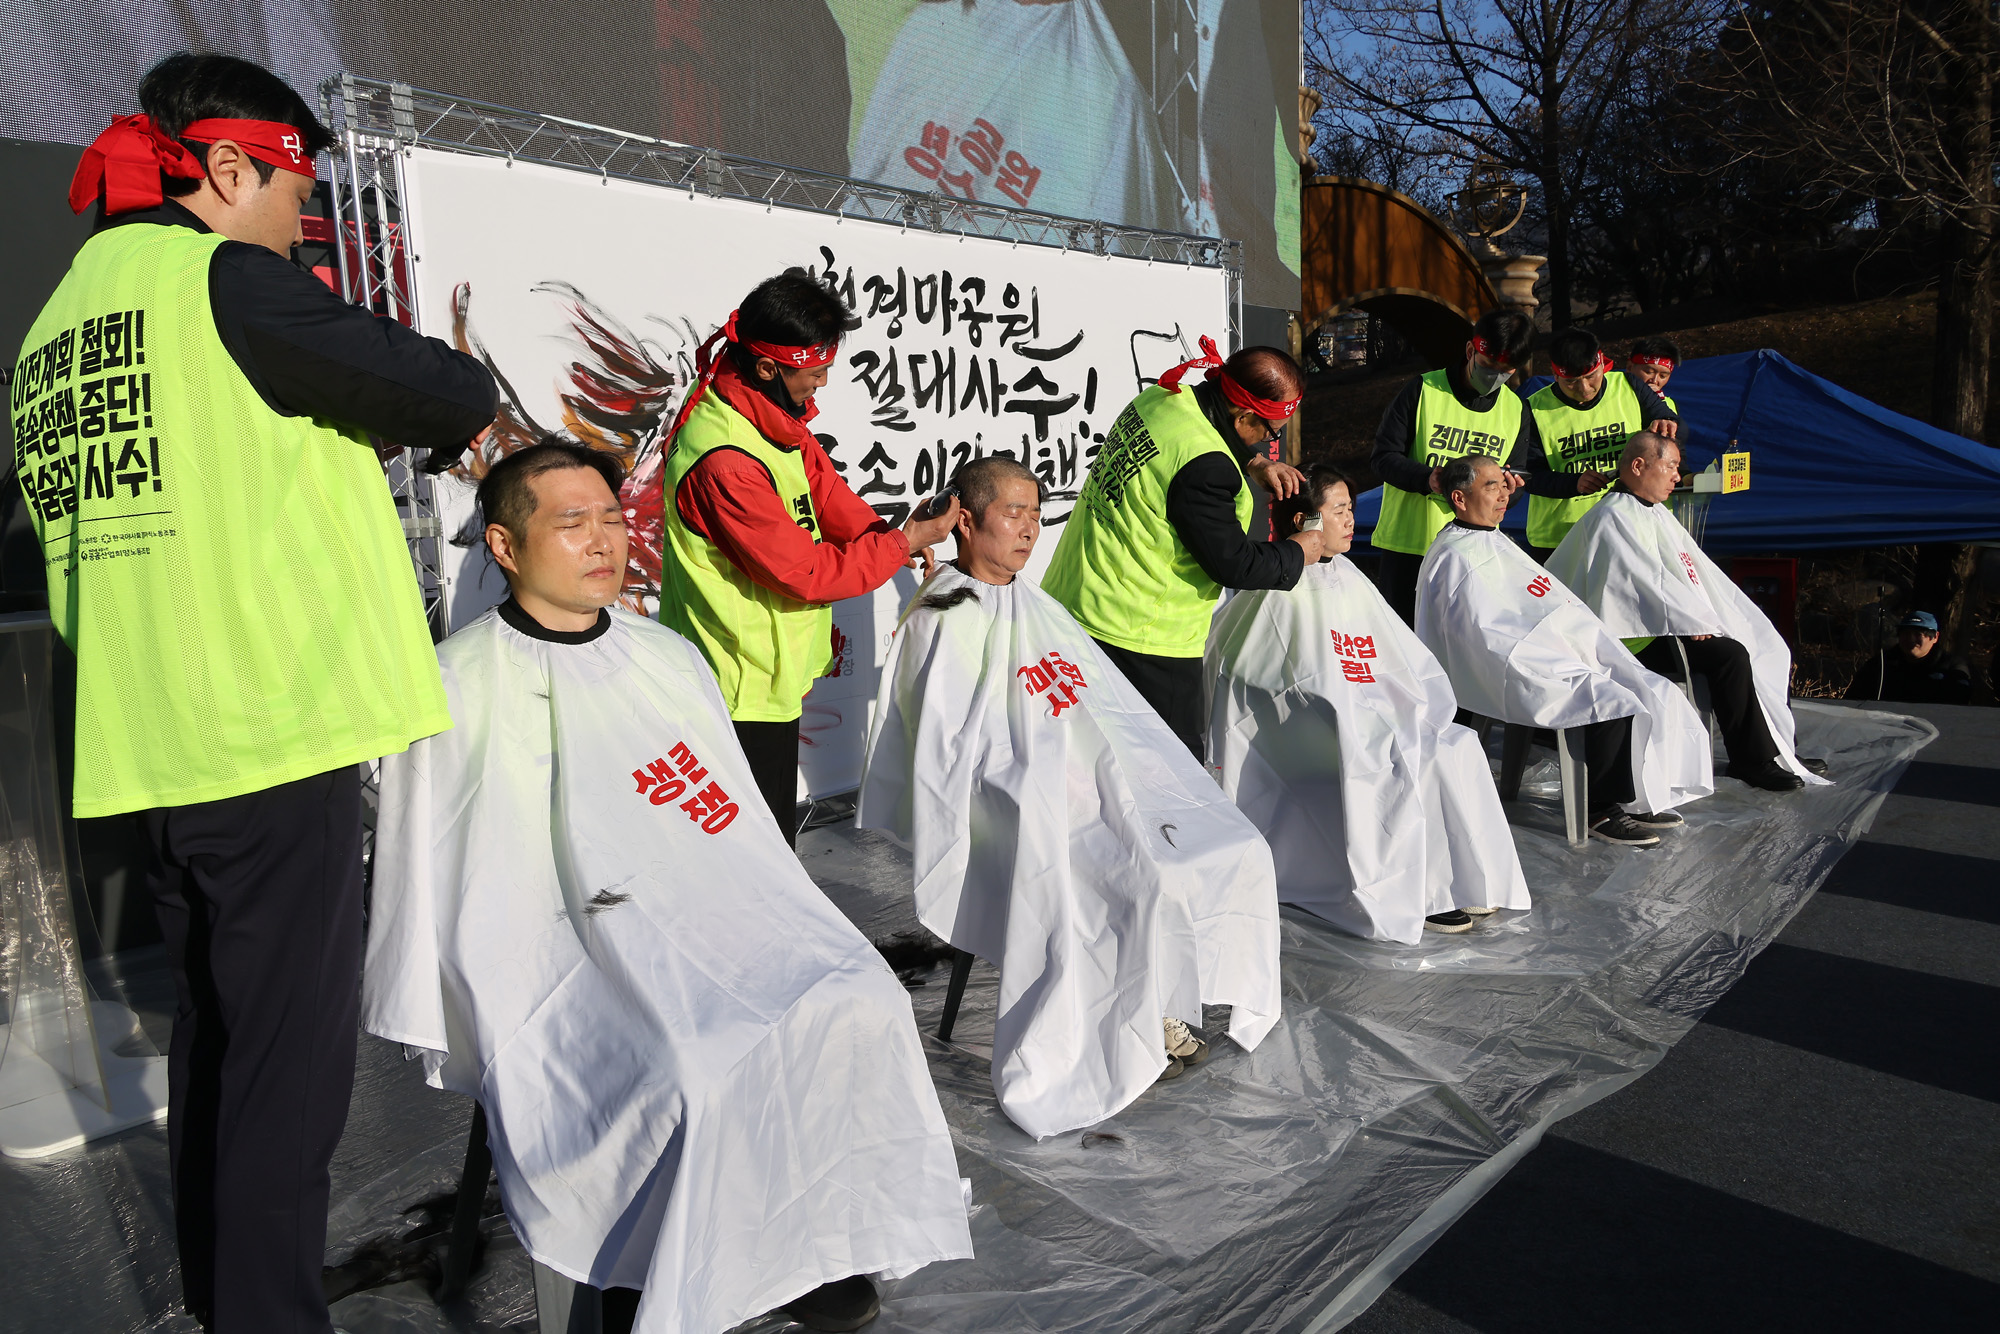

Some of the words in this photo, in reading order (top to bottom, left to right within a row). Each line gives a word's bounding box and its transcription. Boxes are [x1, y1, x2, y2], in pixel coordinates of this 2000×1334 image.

[13, 327, 76, 411] 이전계획
[79, 309, 145, 376] 철회!
[79, 373, 153, 438] 중단!
[850, 345, 1098, 440] 절대사수!
[83, 437, 162, 500] 사수!
[1428, 423, 1505, 461] 경마공원
[1557, 421, 1627, 460] 경마공원
